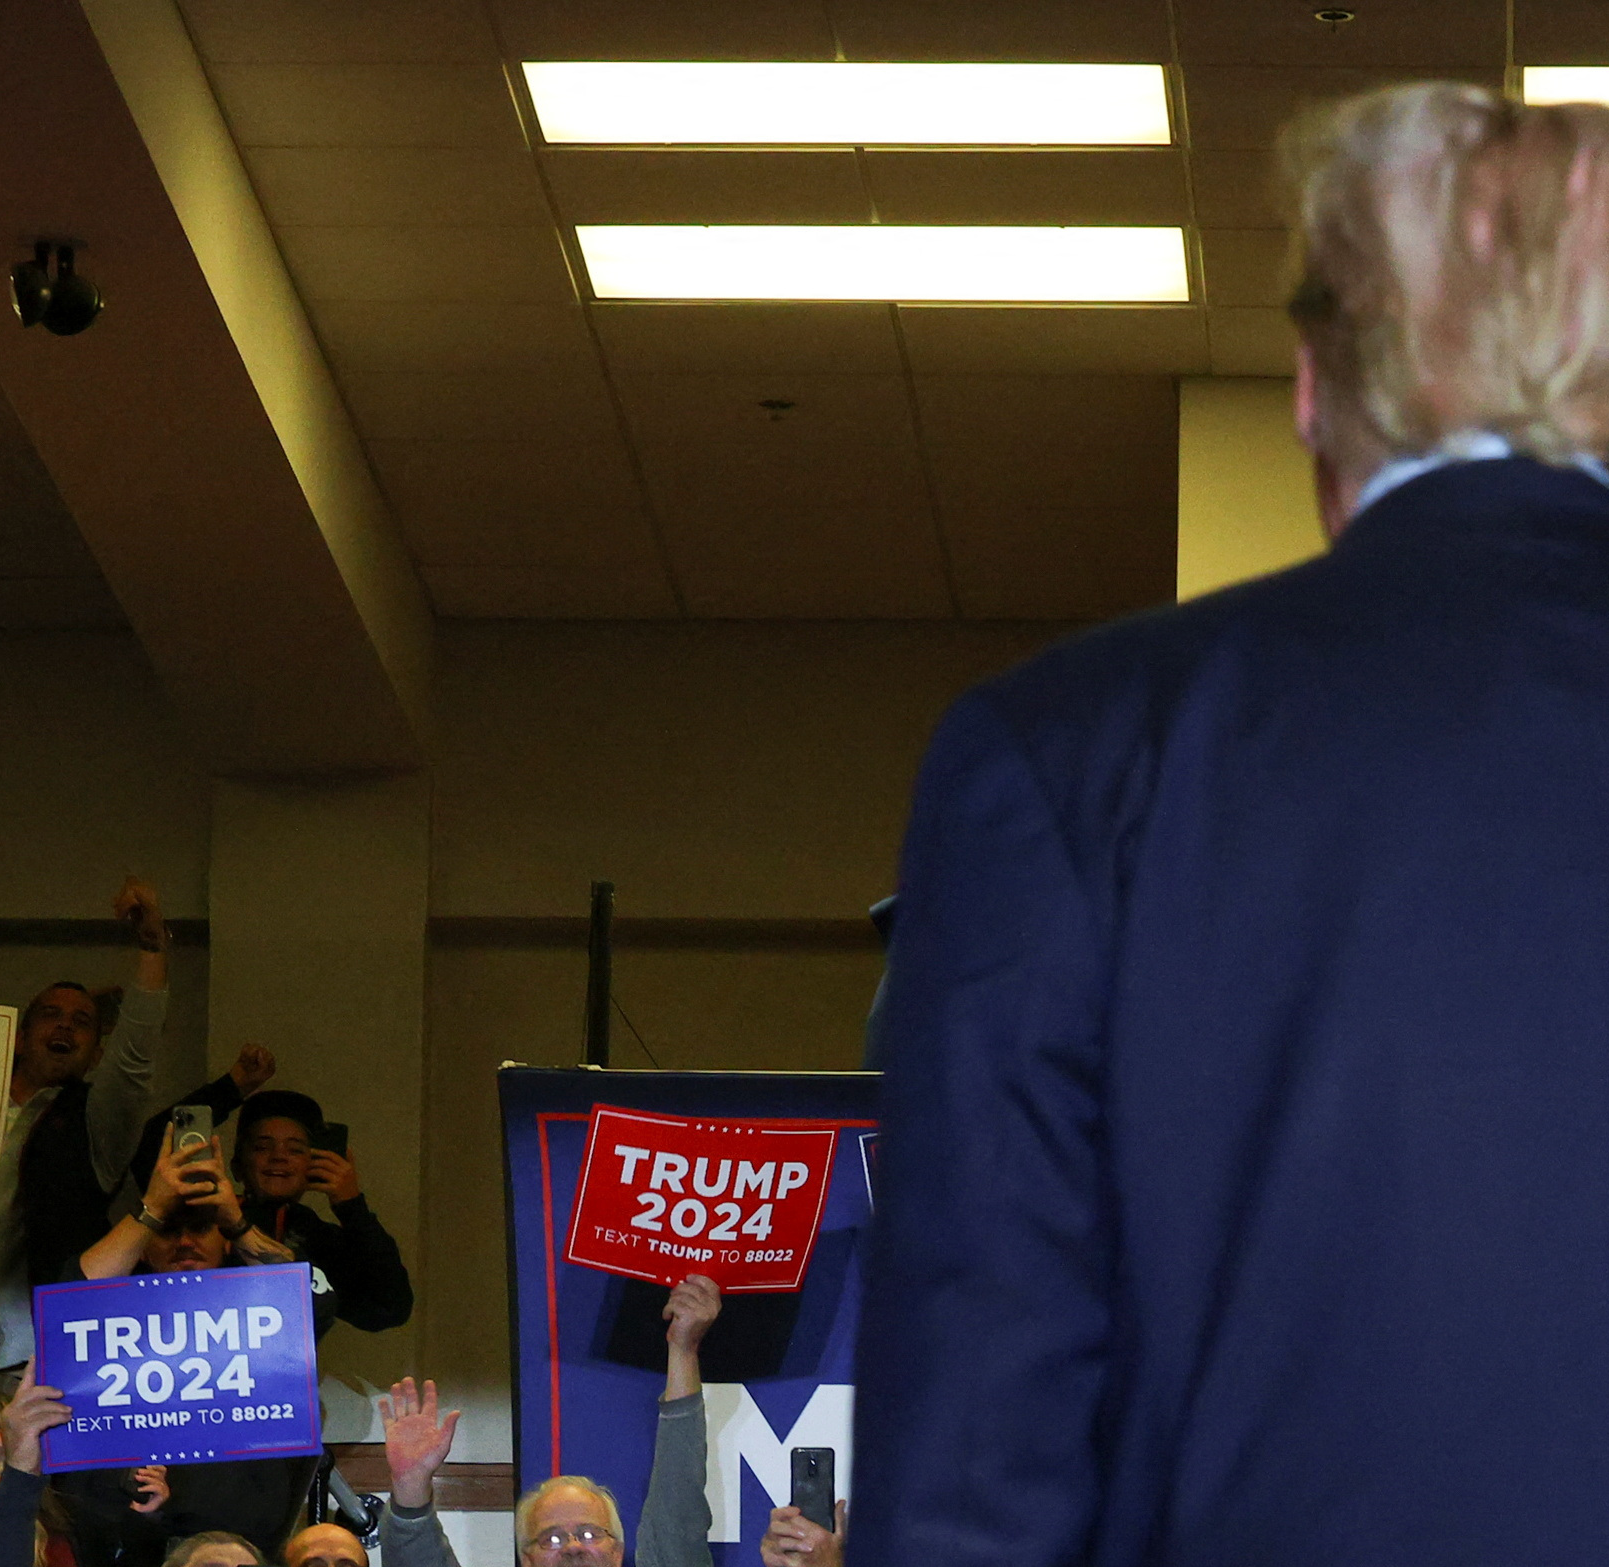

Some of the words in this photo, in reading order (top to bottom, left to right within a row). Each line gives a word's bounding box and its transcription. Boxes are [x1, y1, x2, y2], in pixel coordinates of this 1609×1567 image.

[614, 1144, 810, 1201] TRUMP
[630, 1192, 773, 1242] 2024
[594, 1226, 642, 1248] TEXT
[648, 1238, 713, 1262] TRUMP
[720, 1249, 740, 1263] TO
[745, 1249, 794, 1263] 88022
[63, 1305, 284, 1363] TRUMP
[96, 1354, 256, 1407] 2024
[121, 1410, 191, 1430] TRUMP
[197, 1409, 225, 1425] TO
[232, 1403, 295, 1422] 88022
